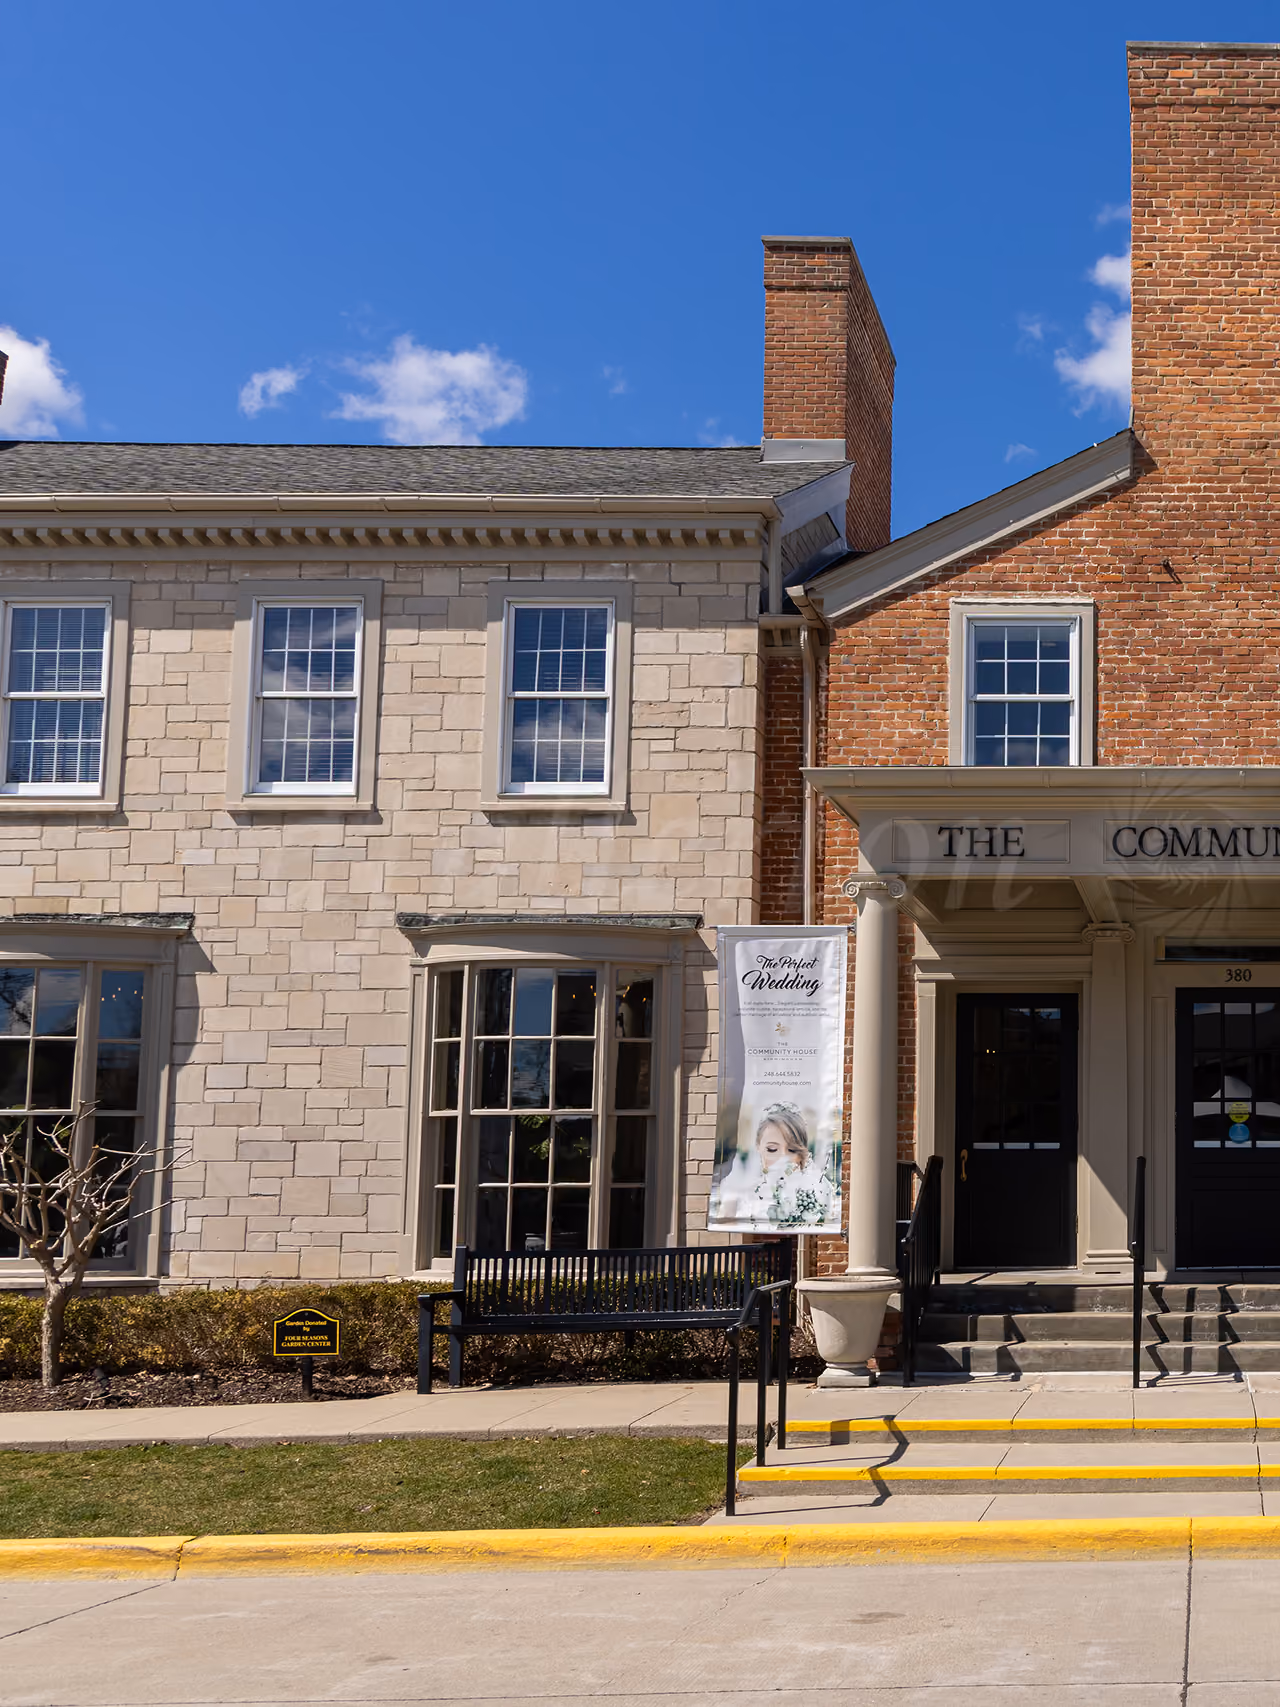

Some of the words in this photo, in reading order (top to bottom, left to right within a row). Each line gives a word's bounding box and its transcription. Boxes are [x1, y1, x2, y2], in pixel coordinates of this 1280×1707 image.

[938, 826, 1026, 858] THE
[756, 955, 778, 970] The
[779, 956, 819, 972] Perfect
[742, 970, 824, 997] Wedding
[1225, 968, 1252, 982] 380
